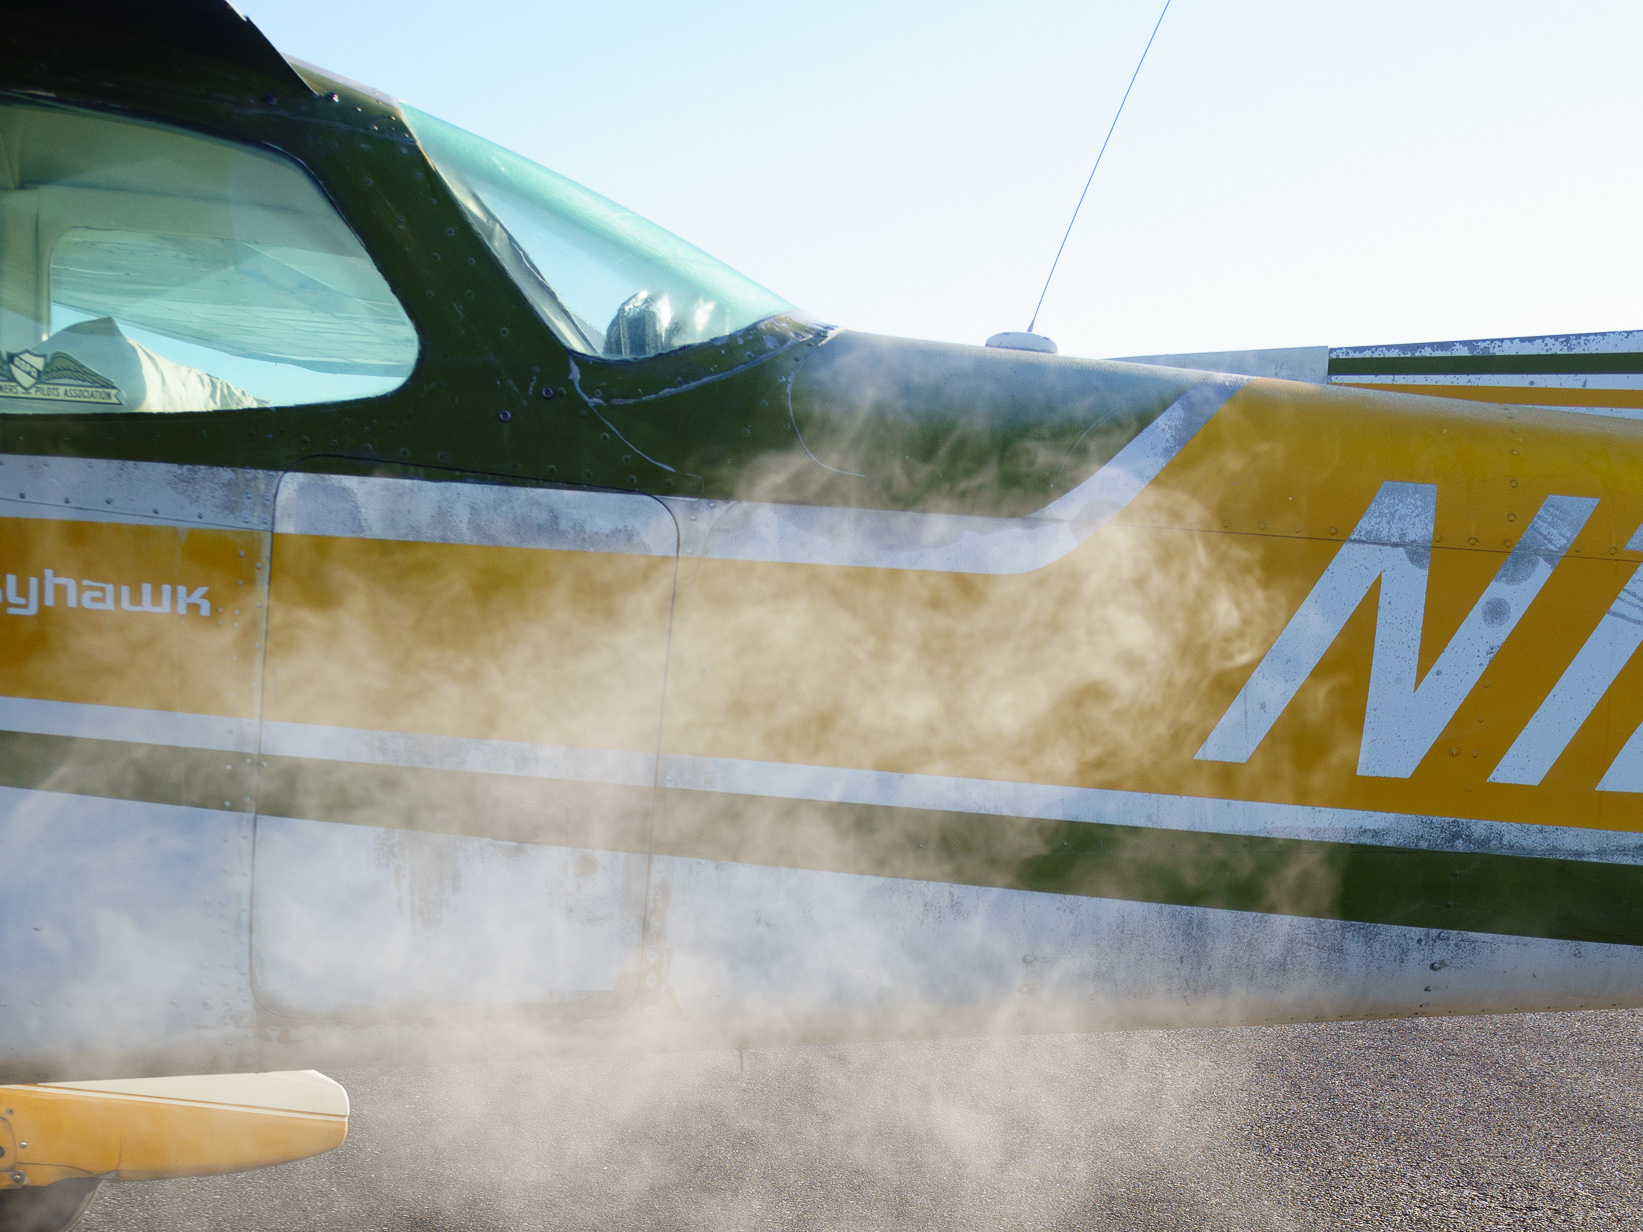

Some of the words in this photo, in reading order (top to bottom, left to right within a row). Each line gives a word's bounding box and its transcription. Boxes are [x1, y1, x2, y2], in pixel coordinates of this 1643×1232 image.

[34, 386, 60, 397] PILOTS
[64, 388, 112, 401] ASSOCIATION
[0, 568, 211, 617] yhawk
[1193, 481, 1643, 793] N1
